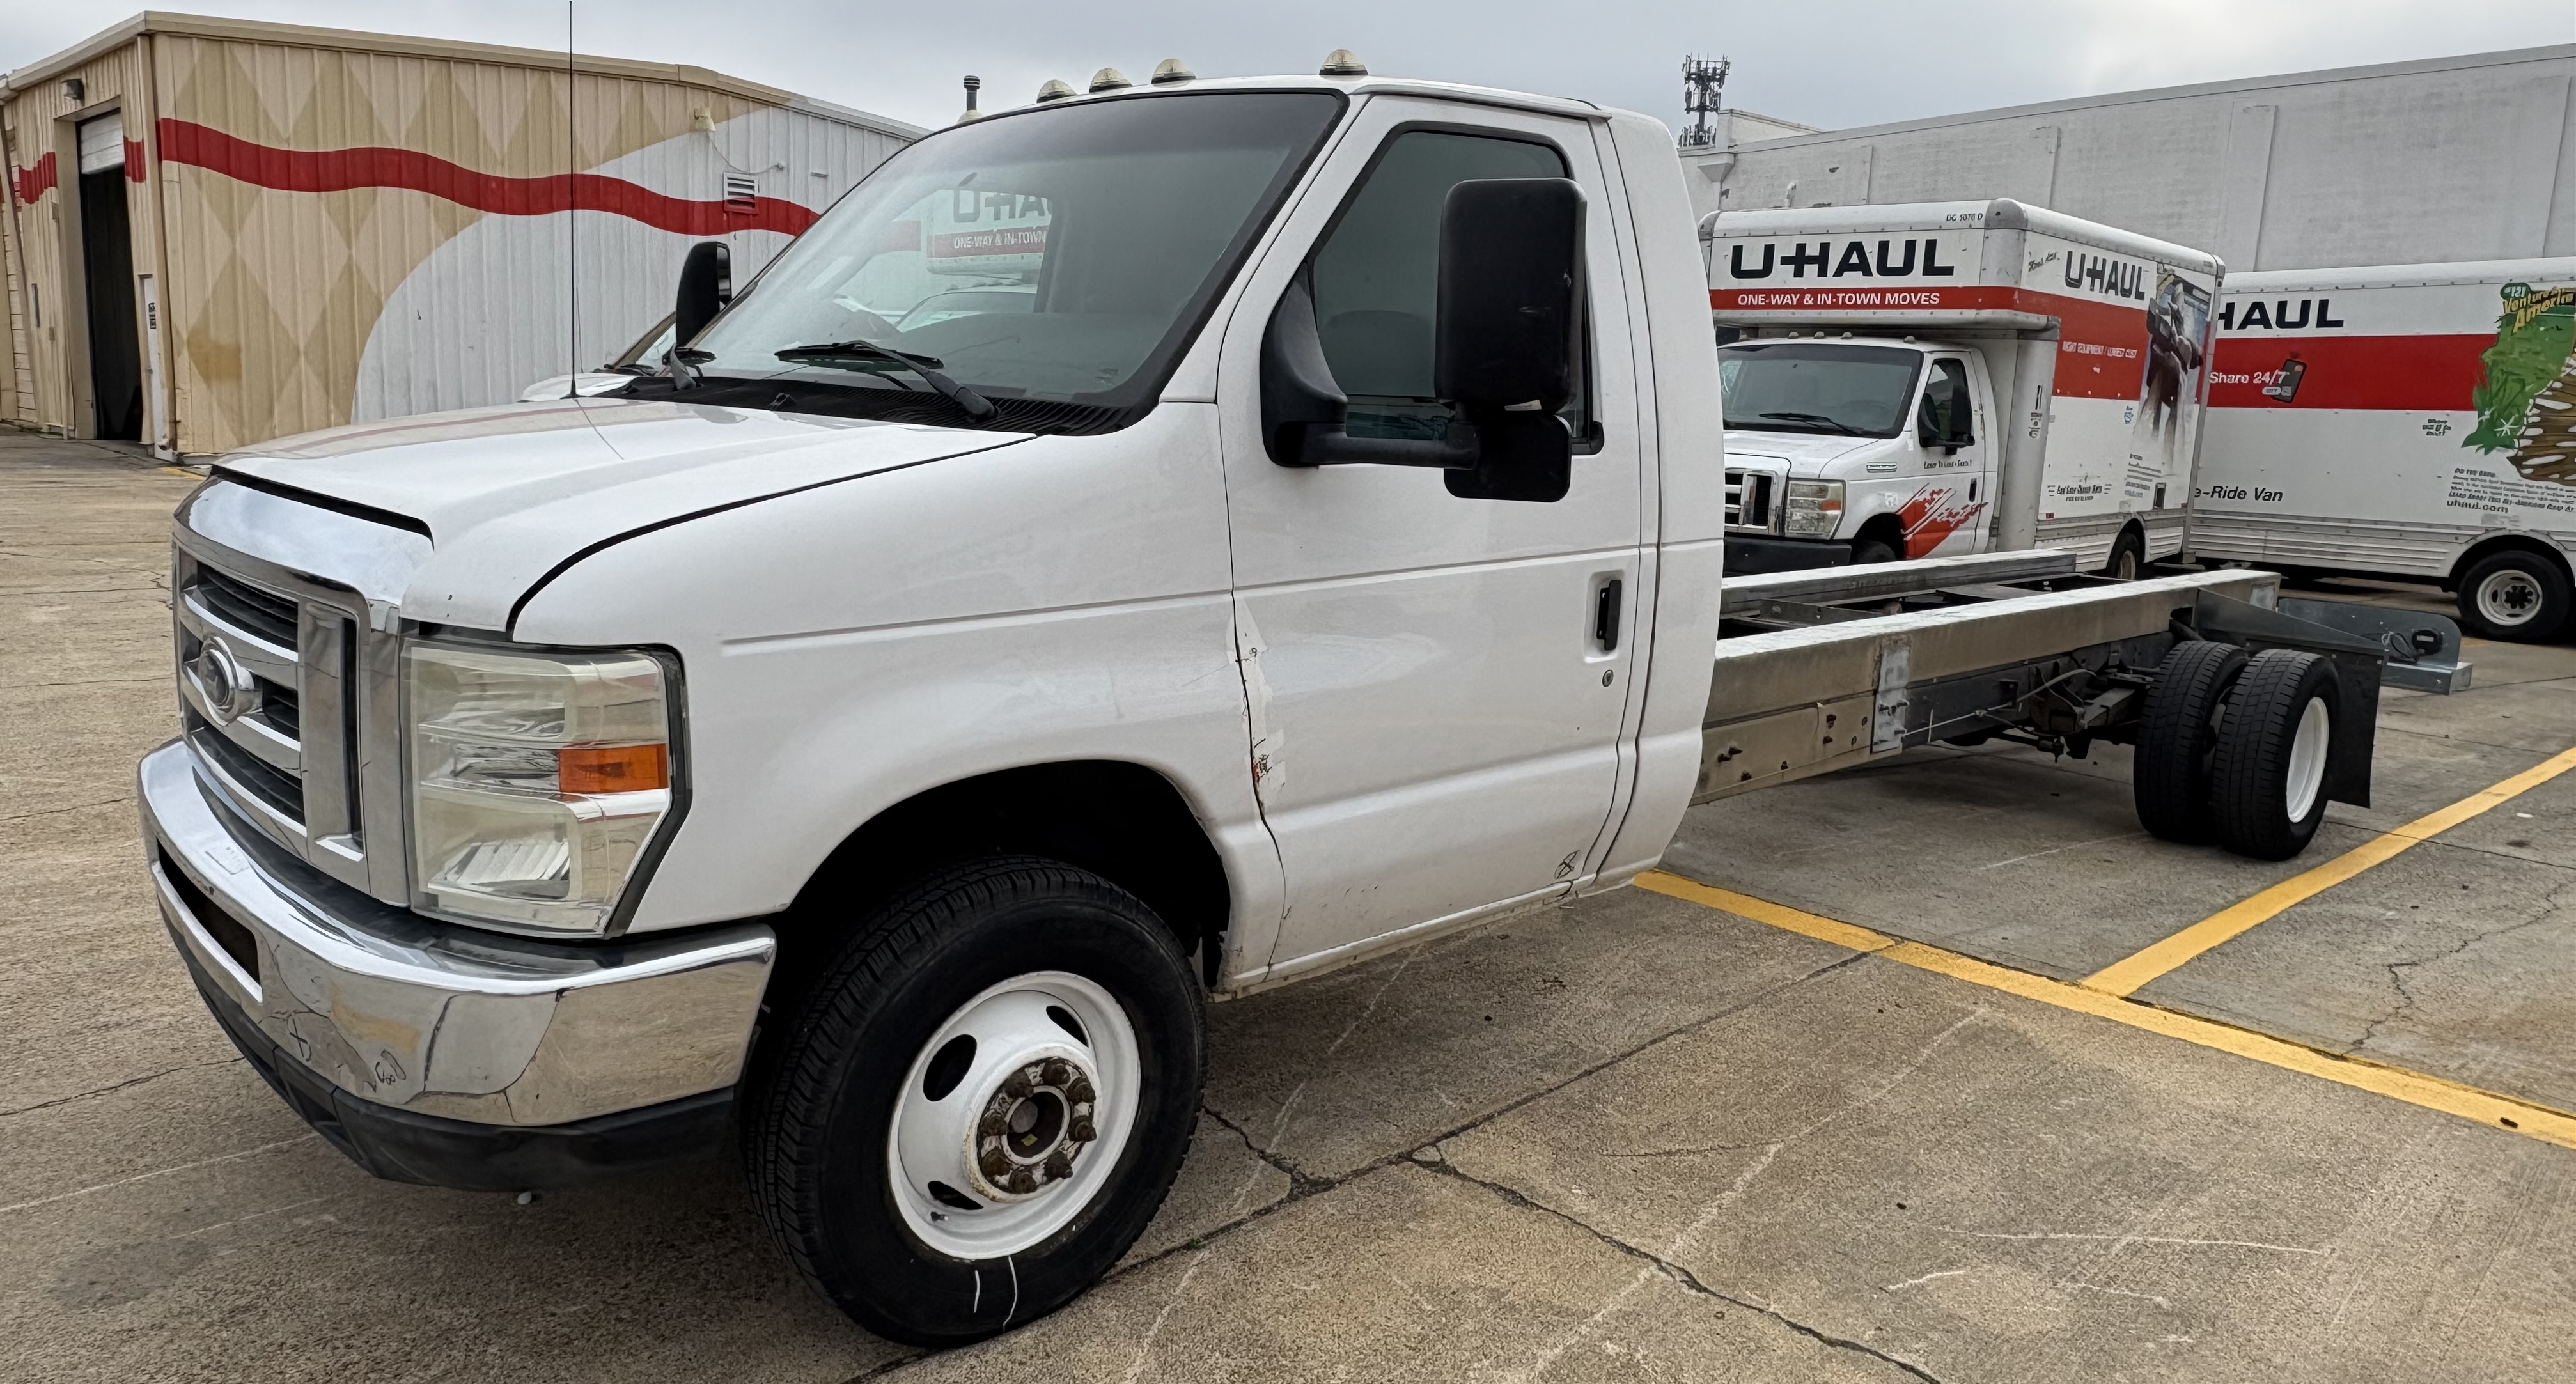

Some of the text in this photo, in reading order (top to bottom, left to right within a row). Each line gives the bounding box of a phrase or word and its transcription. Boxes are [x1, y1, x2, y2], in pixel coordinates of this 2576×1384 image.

[954, 190, 1052, 223] U-HA
[1730, 238, 1955, 279] U-HAUL
[2065, 251, 2146, 301] U-HAUL
[1738, 292, 1940, 306] ONE-WAY & IN-TOWN MOVES
[2208, 369, 2290, 385] Share 24/7
[2254, 486, 2283, 502] Van
